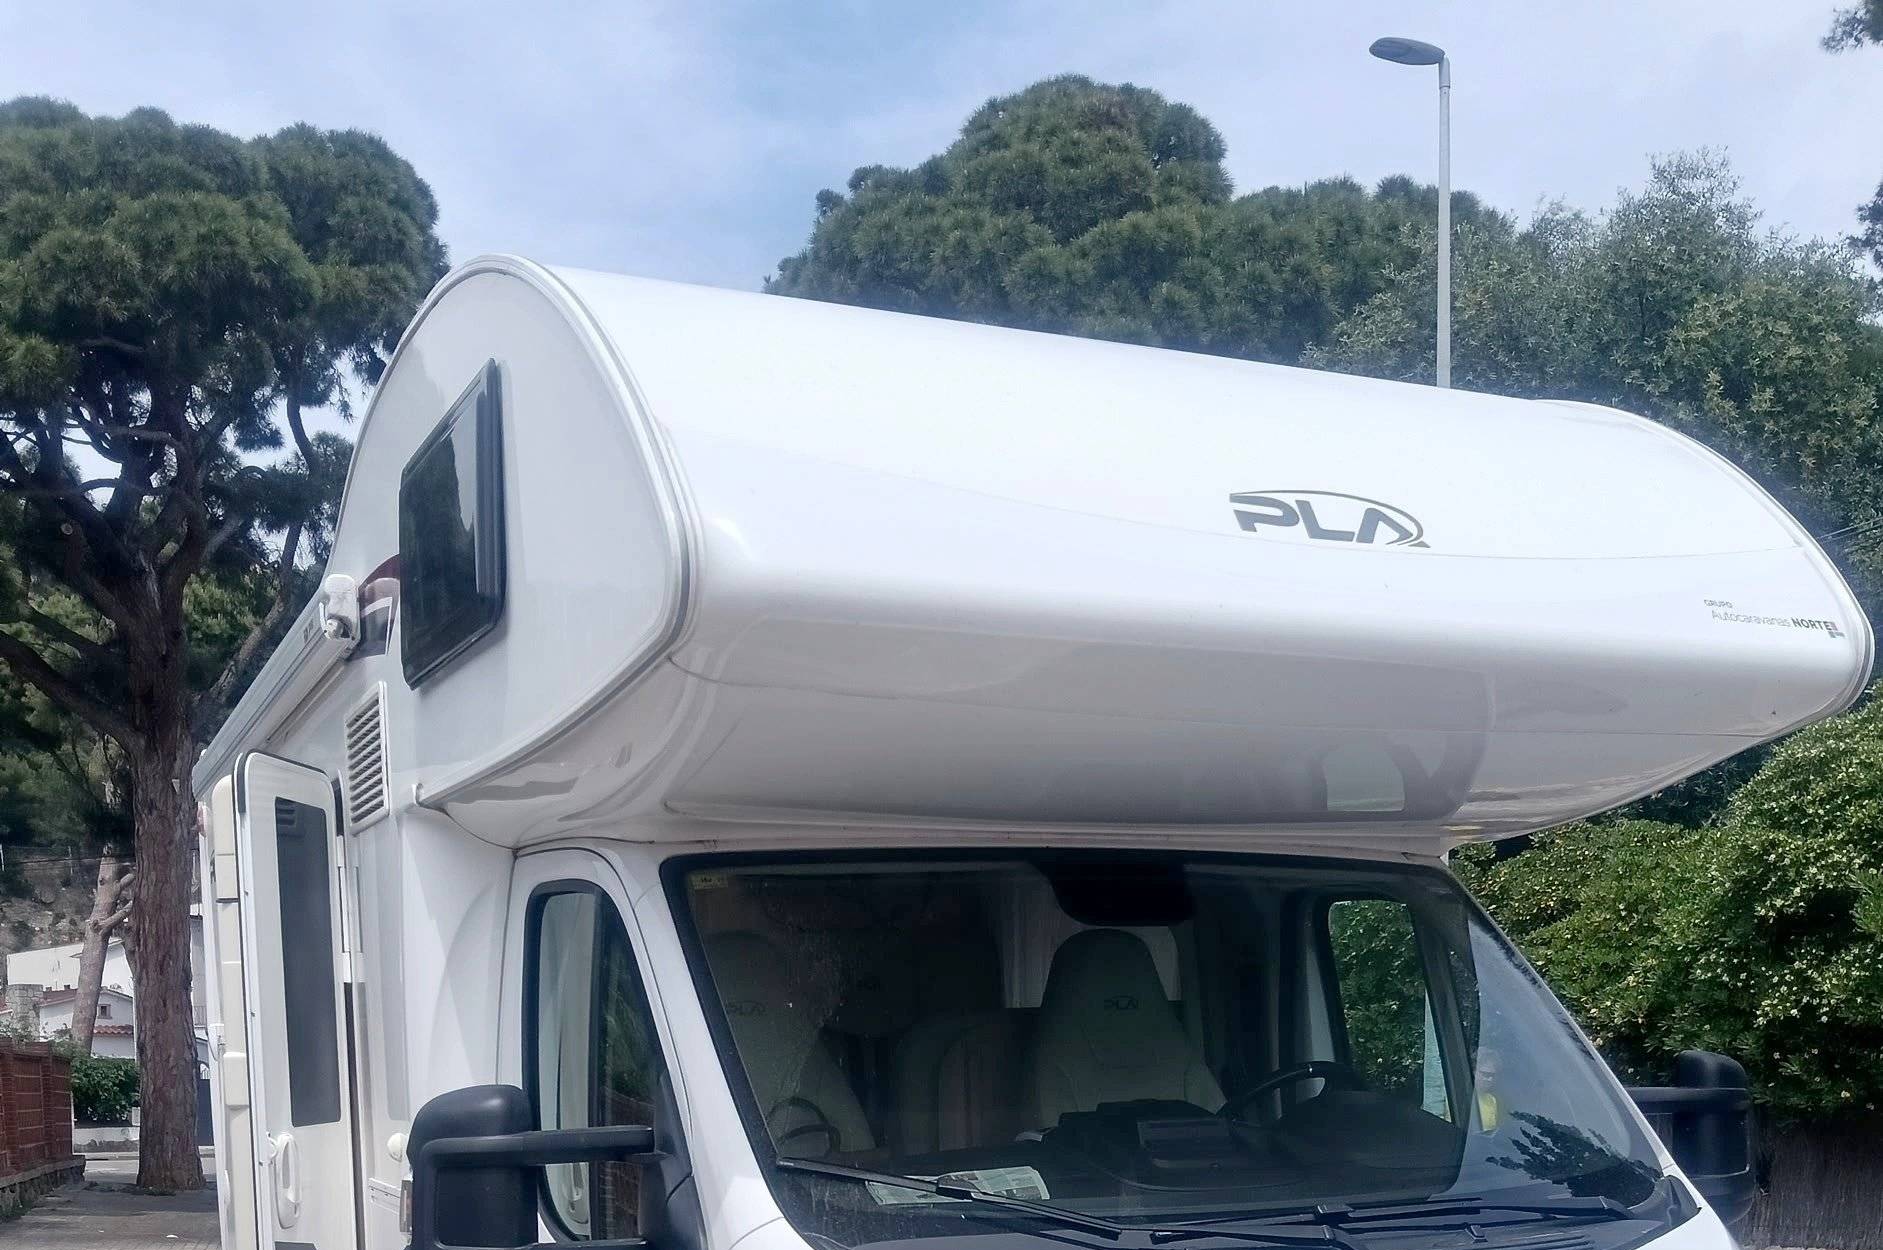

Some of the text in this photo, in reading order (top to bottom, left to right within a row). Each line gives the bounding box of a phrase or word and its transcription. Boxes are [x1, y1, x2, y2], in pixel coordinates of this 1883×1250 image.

[1229, 491, 1420, 546] PLA
[1703, 599, 1733, 609] GRUPO
[1791, 617, 1832, 631] NORTE
